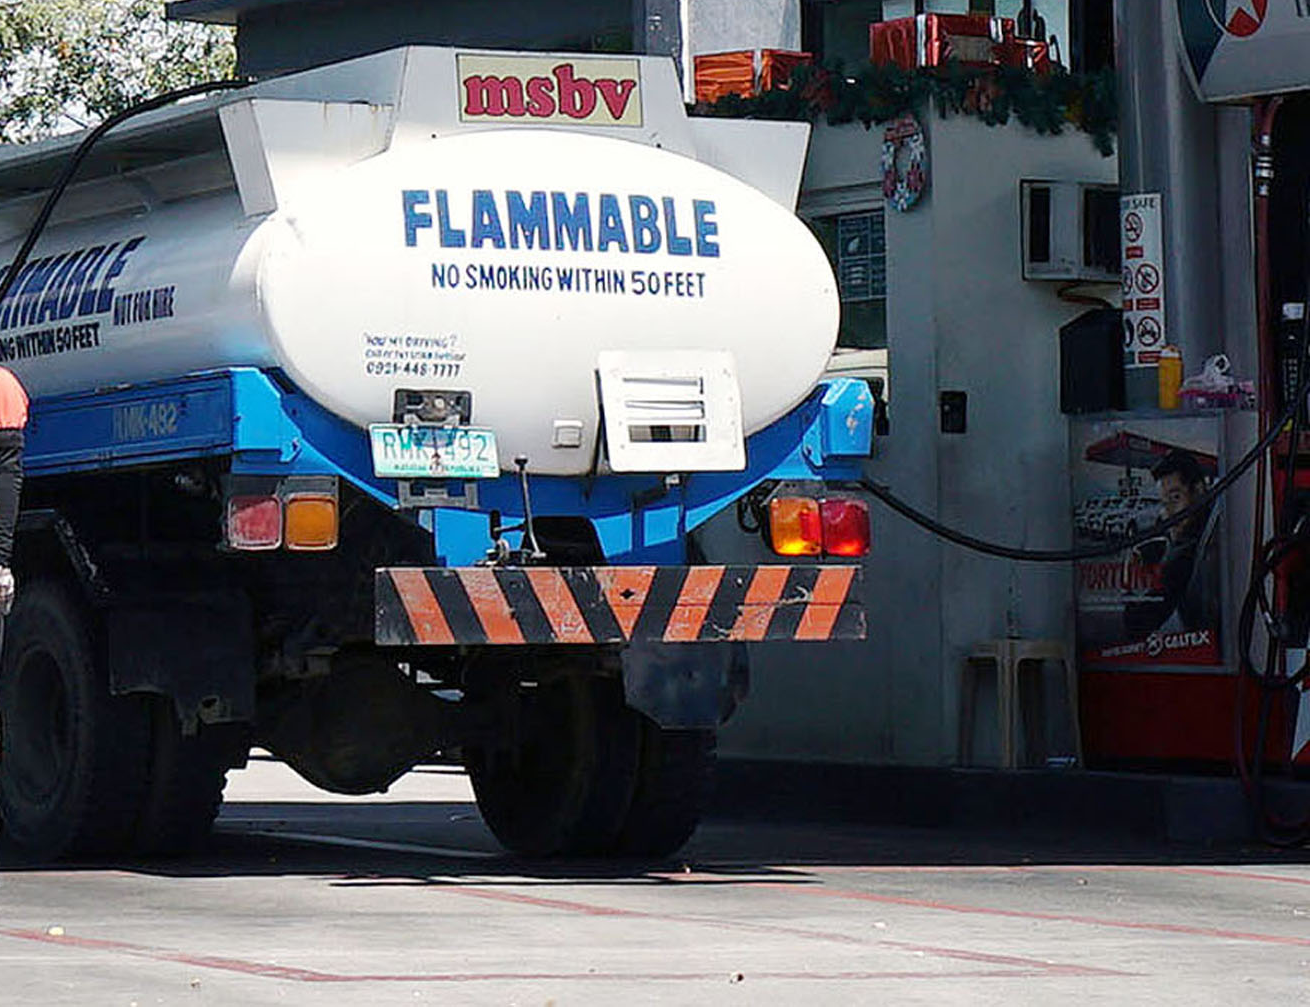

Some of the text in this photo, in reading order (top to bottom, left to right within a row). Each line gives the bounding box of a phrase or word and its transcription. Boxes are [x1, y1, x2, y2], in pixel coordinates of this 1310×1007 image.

[463, 63, 637, 120] msbv
[401, 189, 721, 258] FLAMMABLE
[431, 263, 706, 298] NO SMOKING WITHIN 50 FEET
[56, 325, 72, 354] 50
[73, 321, 101, 351] FEET
